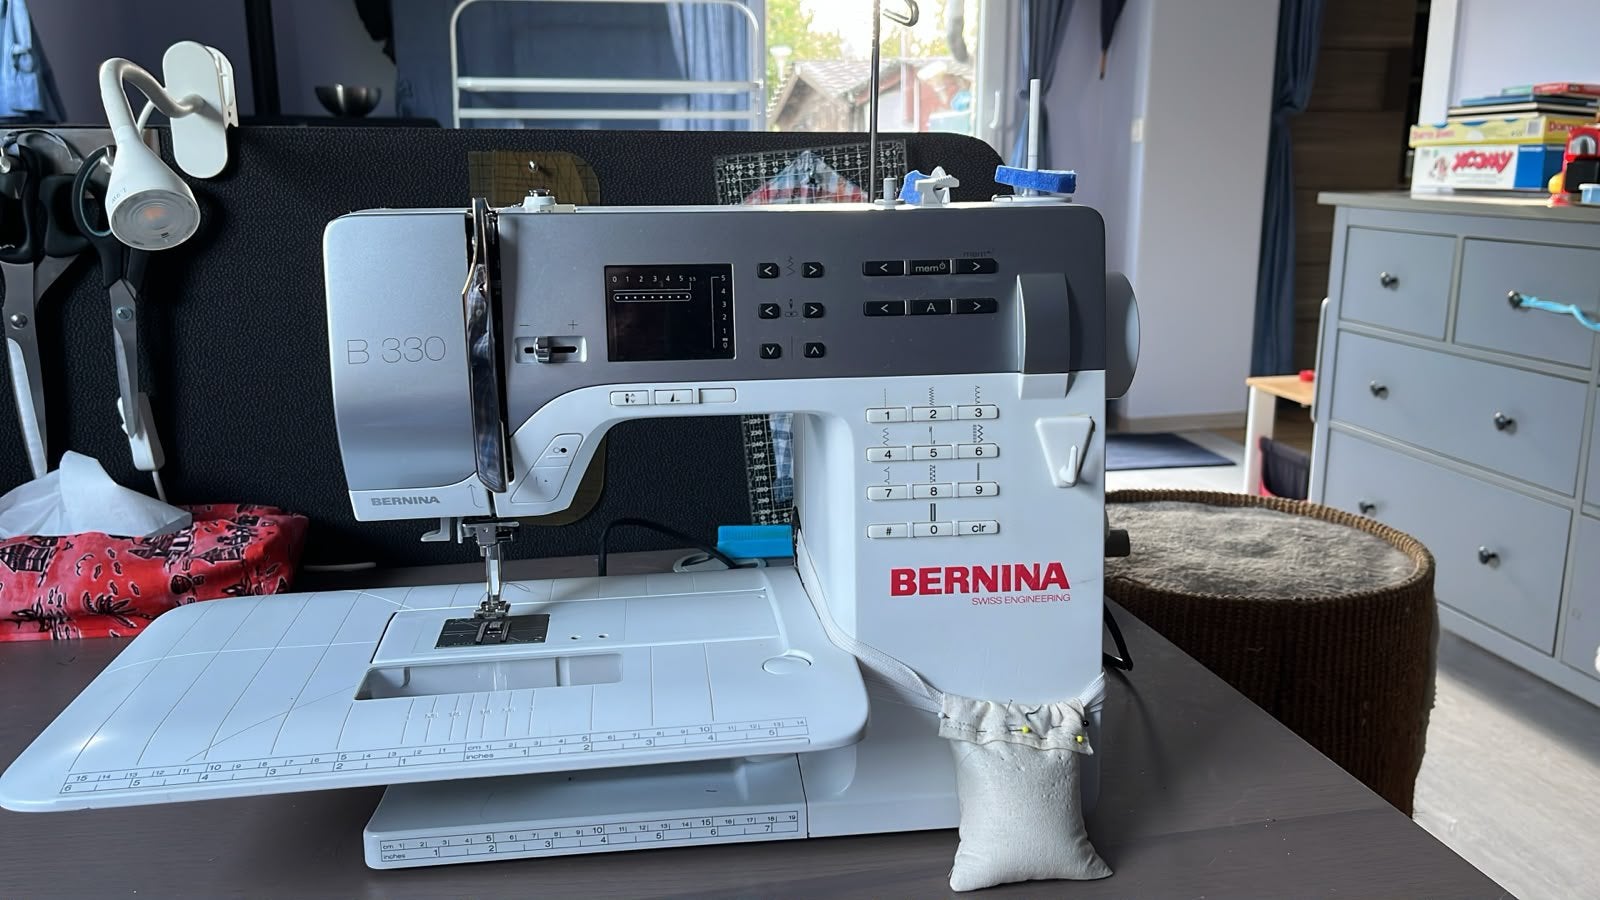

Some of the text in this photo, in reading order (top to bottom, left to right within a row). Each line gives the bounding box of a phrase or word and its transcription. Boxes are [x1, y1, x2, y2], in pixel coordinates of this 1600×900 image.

[926, 303, 936, 312] A
[347, 336, 446, 364] B 330
[885, 409, 982, 420] 1 2 3
[885, 447, 983, 459] 4 5 6
[885, 486, 983, 497] 7 8 9
[371, 496, 440, 506] BERNINA
[930, 526, 937, 534] 0
[972, 524, 986, 533] clr
[891, 562, 1070, 596] BERNINA
[972, 594, 1071, 606] SWISS ENGINEERING
[592, 826, 603, 834] 10
[700, 818, 711, 826] 15
[544, 840, 551, 848] 3
[710, 828, 716, 836] 6
